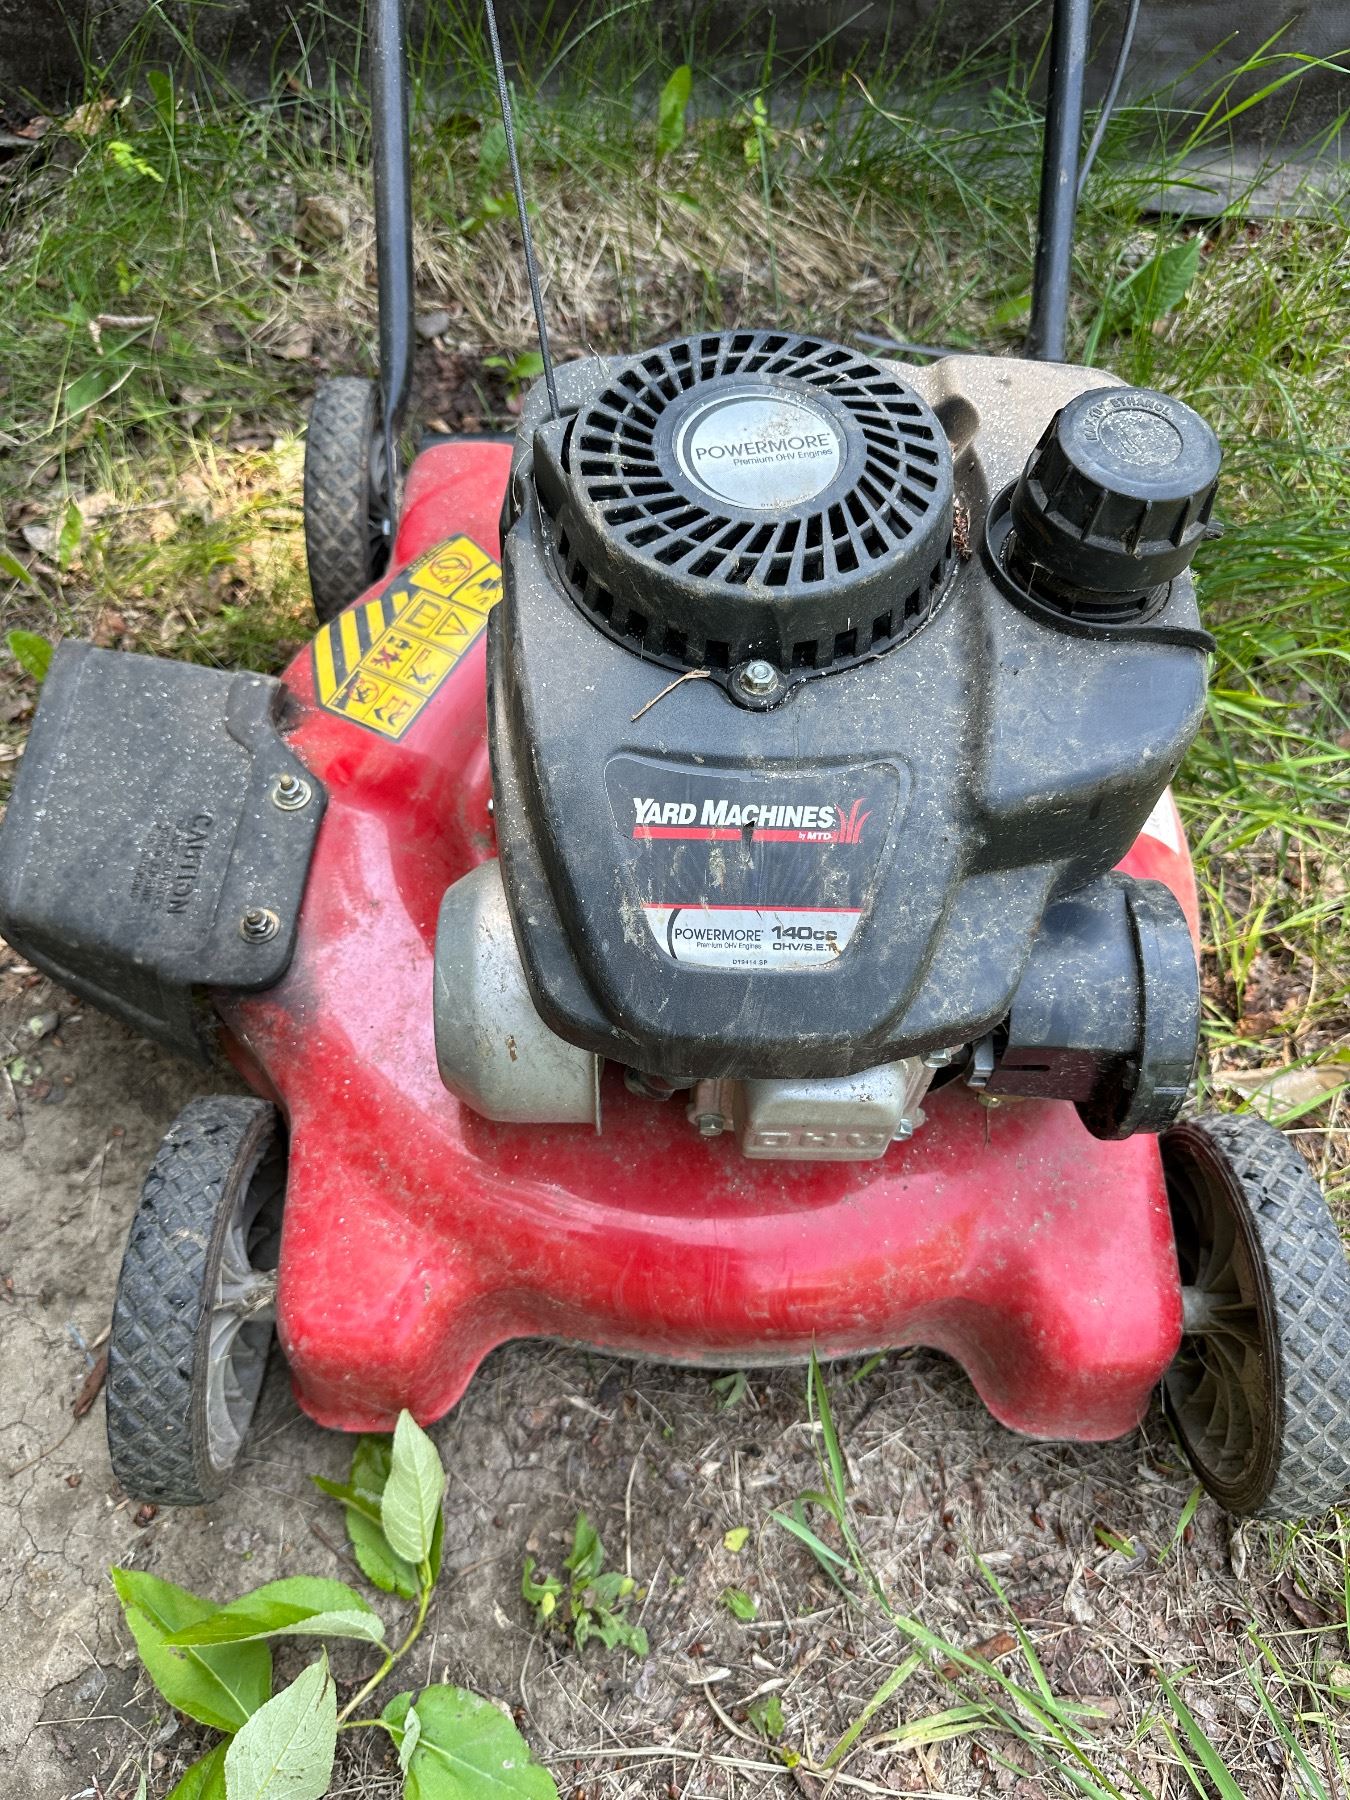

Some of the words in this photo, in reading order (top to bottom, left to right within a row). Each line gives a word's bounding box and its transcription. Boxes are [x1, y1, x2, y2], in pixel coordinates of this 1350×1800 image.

[1110, 397, 1170, 417] ETHANOL
[695, 432, 831, 460] POWERMORE
[733, 456, 774, 467] Premium
[776, 453, 796, 462] OHV
[798, 448, 833, 460] Engines
[632, 797, 697, 825] YARD
[700, 799, 835, 829] MACHINES
[798, 831, 806, 840] by
[807, 831, 831, 840] MTD
[166, 814, 214, 914] CAUTION
[674, 928, 763, 942] POWERMORE
[771, 925, 838, 941] 140cc
[696, 941, 723, 950] Premium
[738, 941, 762, 950] Engines
